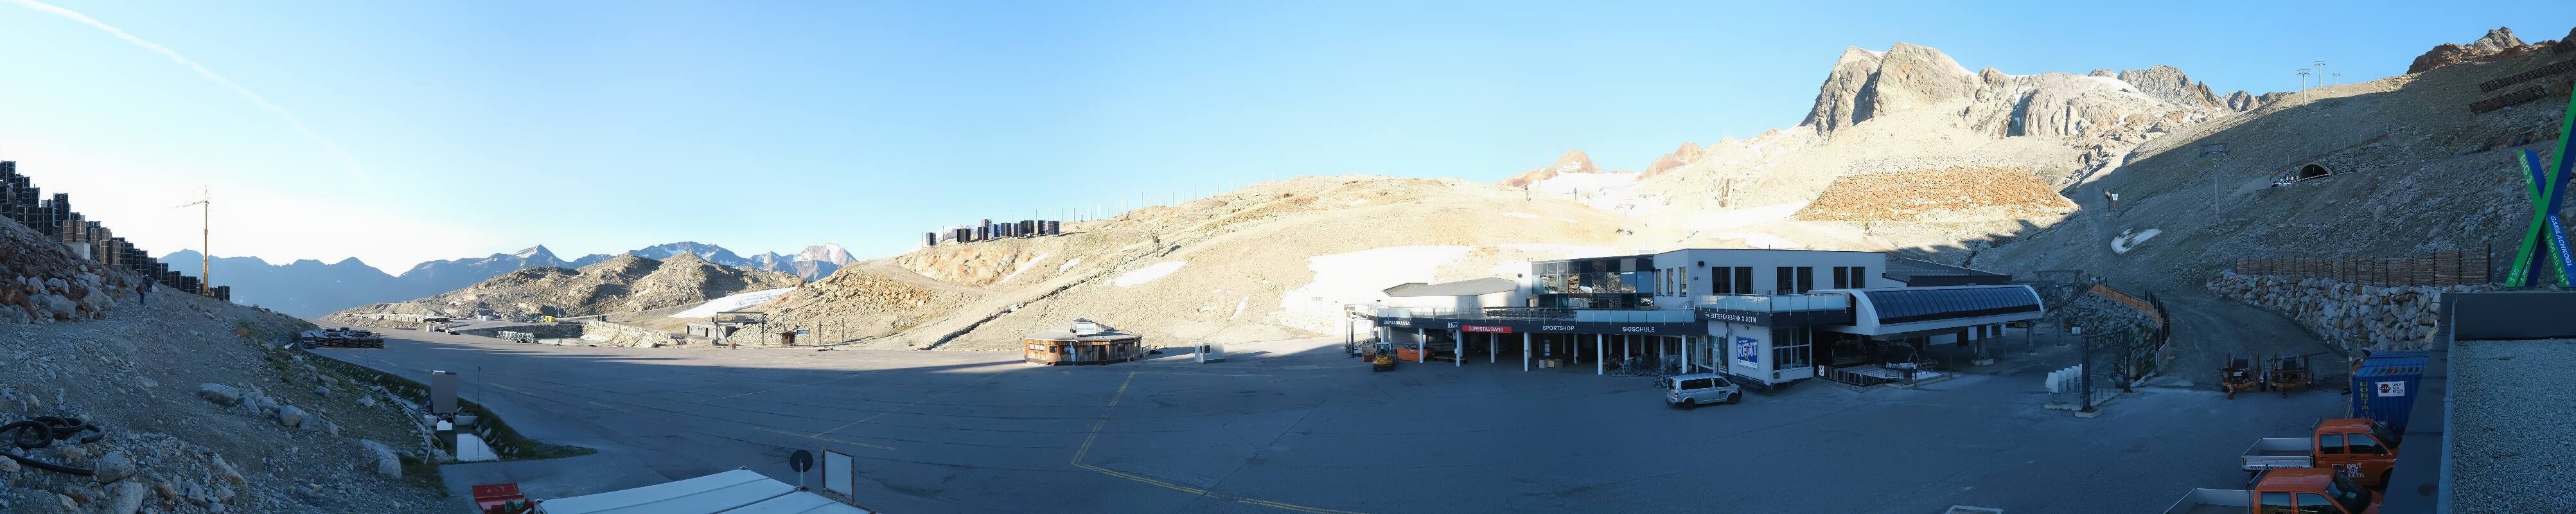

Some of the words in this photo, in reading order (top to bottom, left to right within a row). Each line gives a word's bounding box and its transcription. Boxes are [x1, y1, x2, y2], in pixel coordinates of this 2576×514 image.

[2520, 154, 2530, 175] BIG
[2527, 175, 2532, 184] 3
[2550, 216, 2572, 268] GAISLACHKOGL
